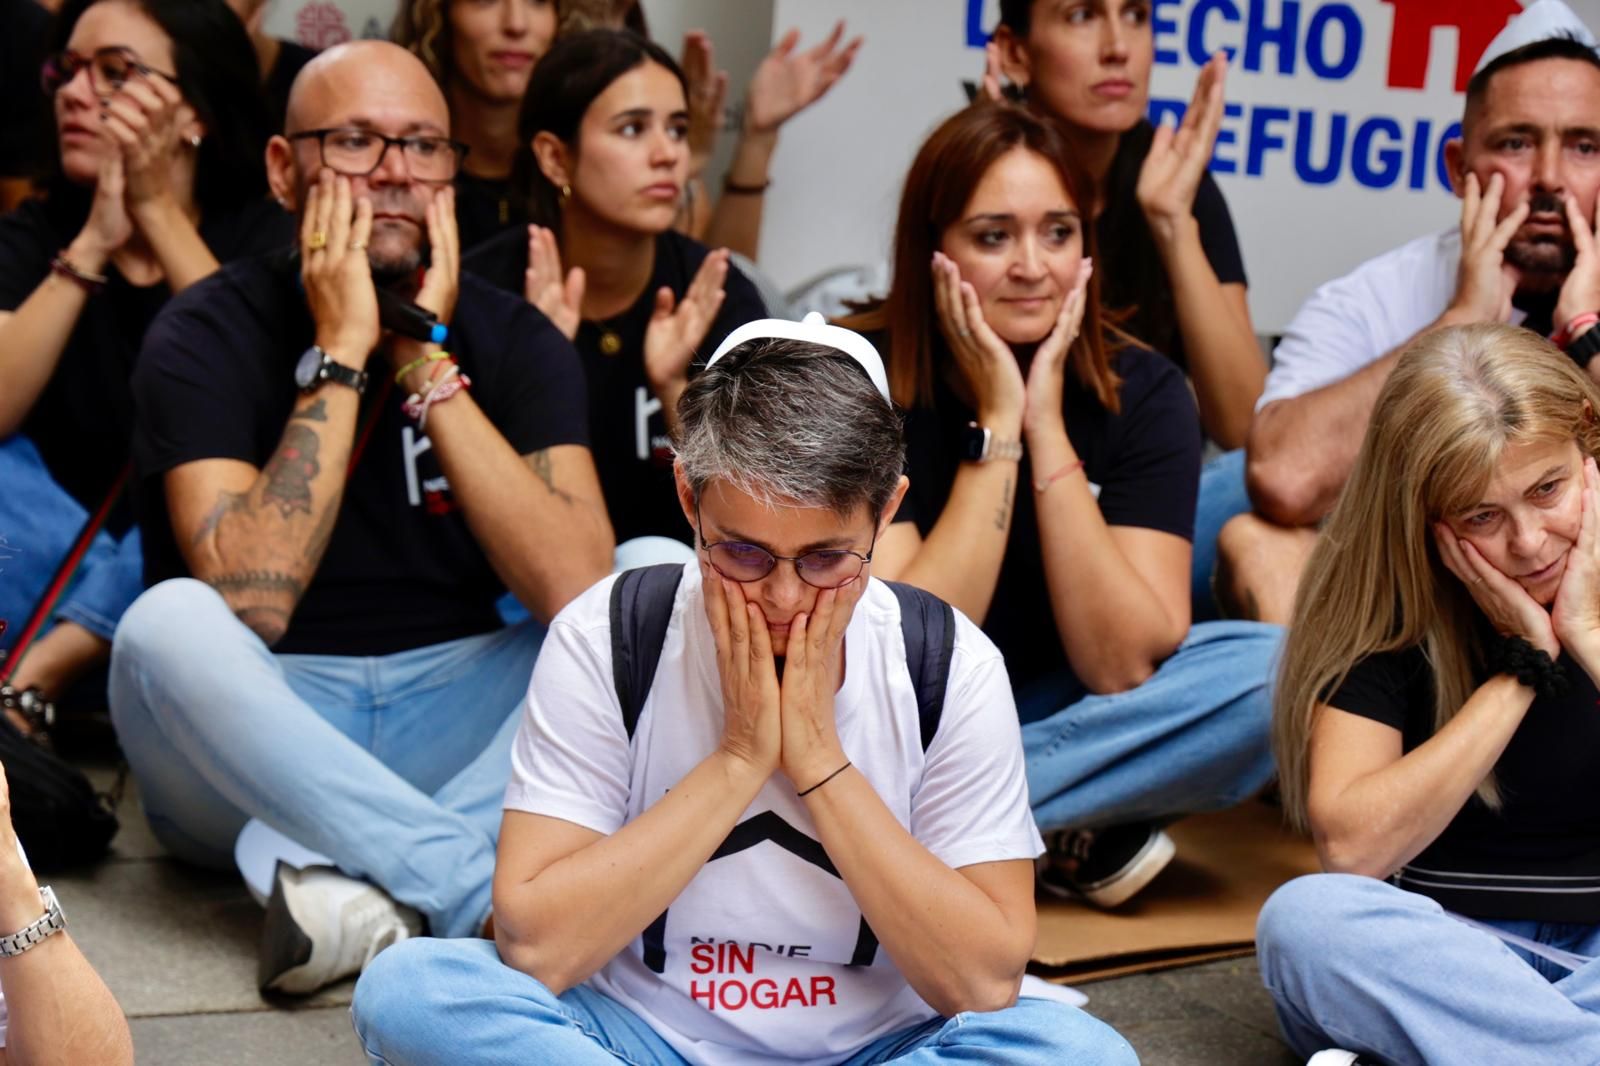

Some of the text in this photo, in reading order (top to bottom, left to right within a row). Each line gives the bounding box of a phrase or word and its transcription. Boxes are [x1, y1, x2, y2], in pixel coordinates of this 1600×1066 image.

[965, 0, 1363, 79] ECHO
[690, 943, 754, 974] SIN
[690, 976, 837, 1011] HOGAR
